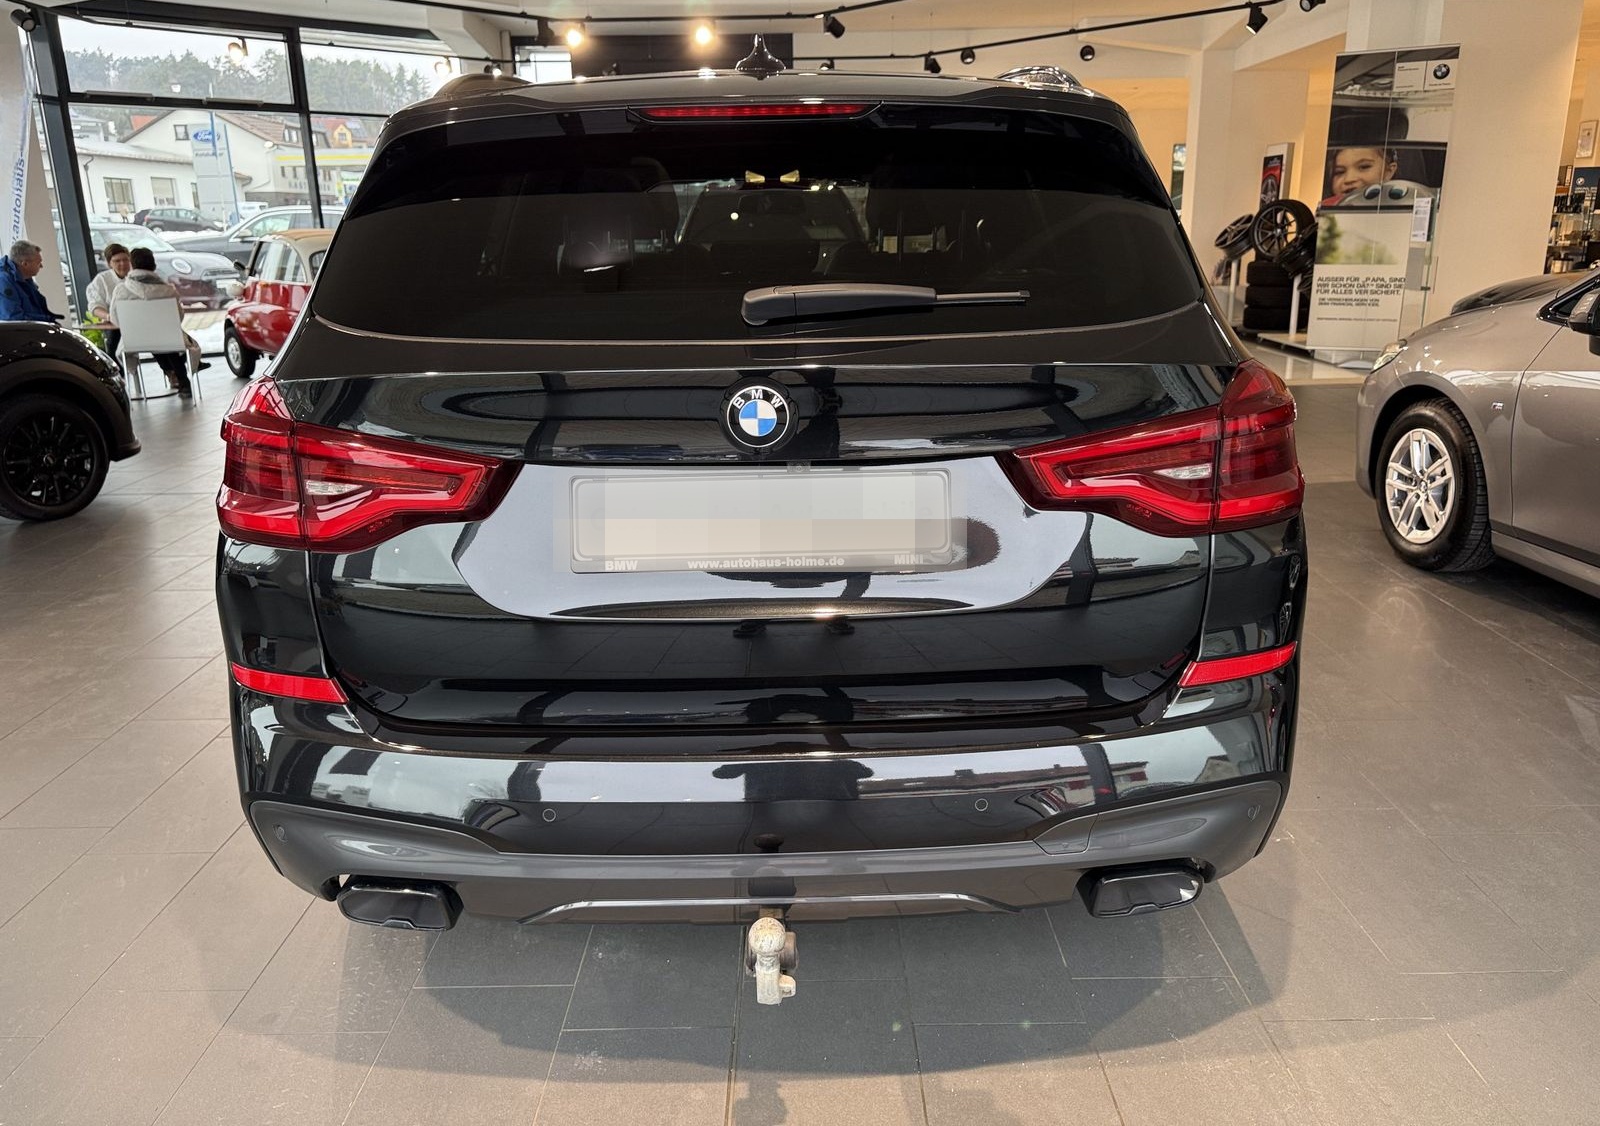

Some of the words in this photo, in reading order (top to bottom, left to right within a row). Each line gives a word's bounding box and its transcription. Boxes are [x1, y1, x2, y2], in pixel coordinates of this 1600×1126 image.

[1346, 275, 1360, 283] FÜR
[733, 389, 783, 410] BMW
[605, 560, 638, 571] BMW
[687, 555, 845, 569] www.autohaus-holme.de
[894, 554, 924, 565] MINI
